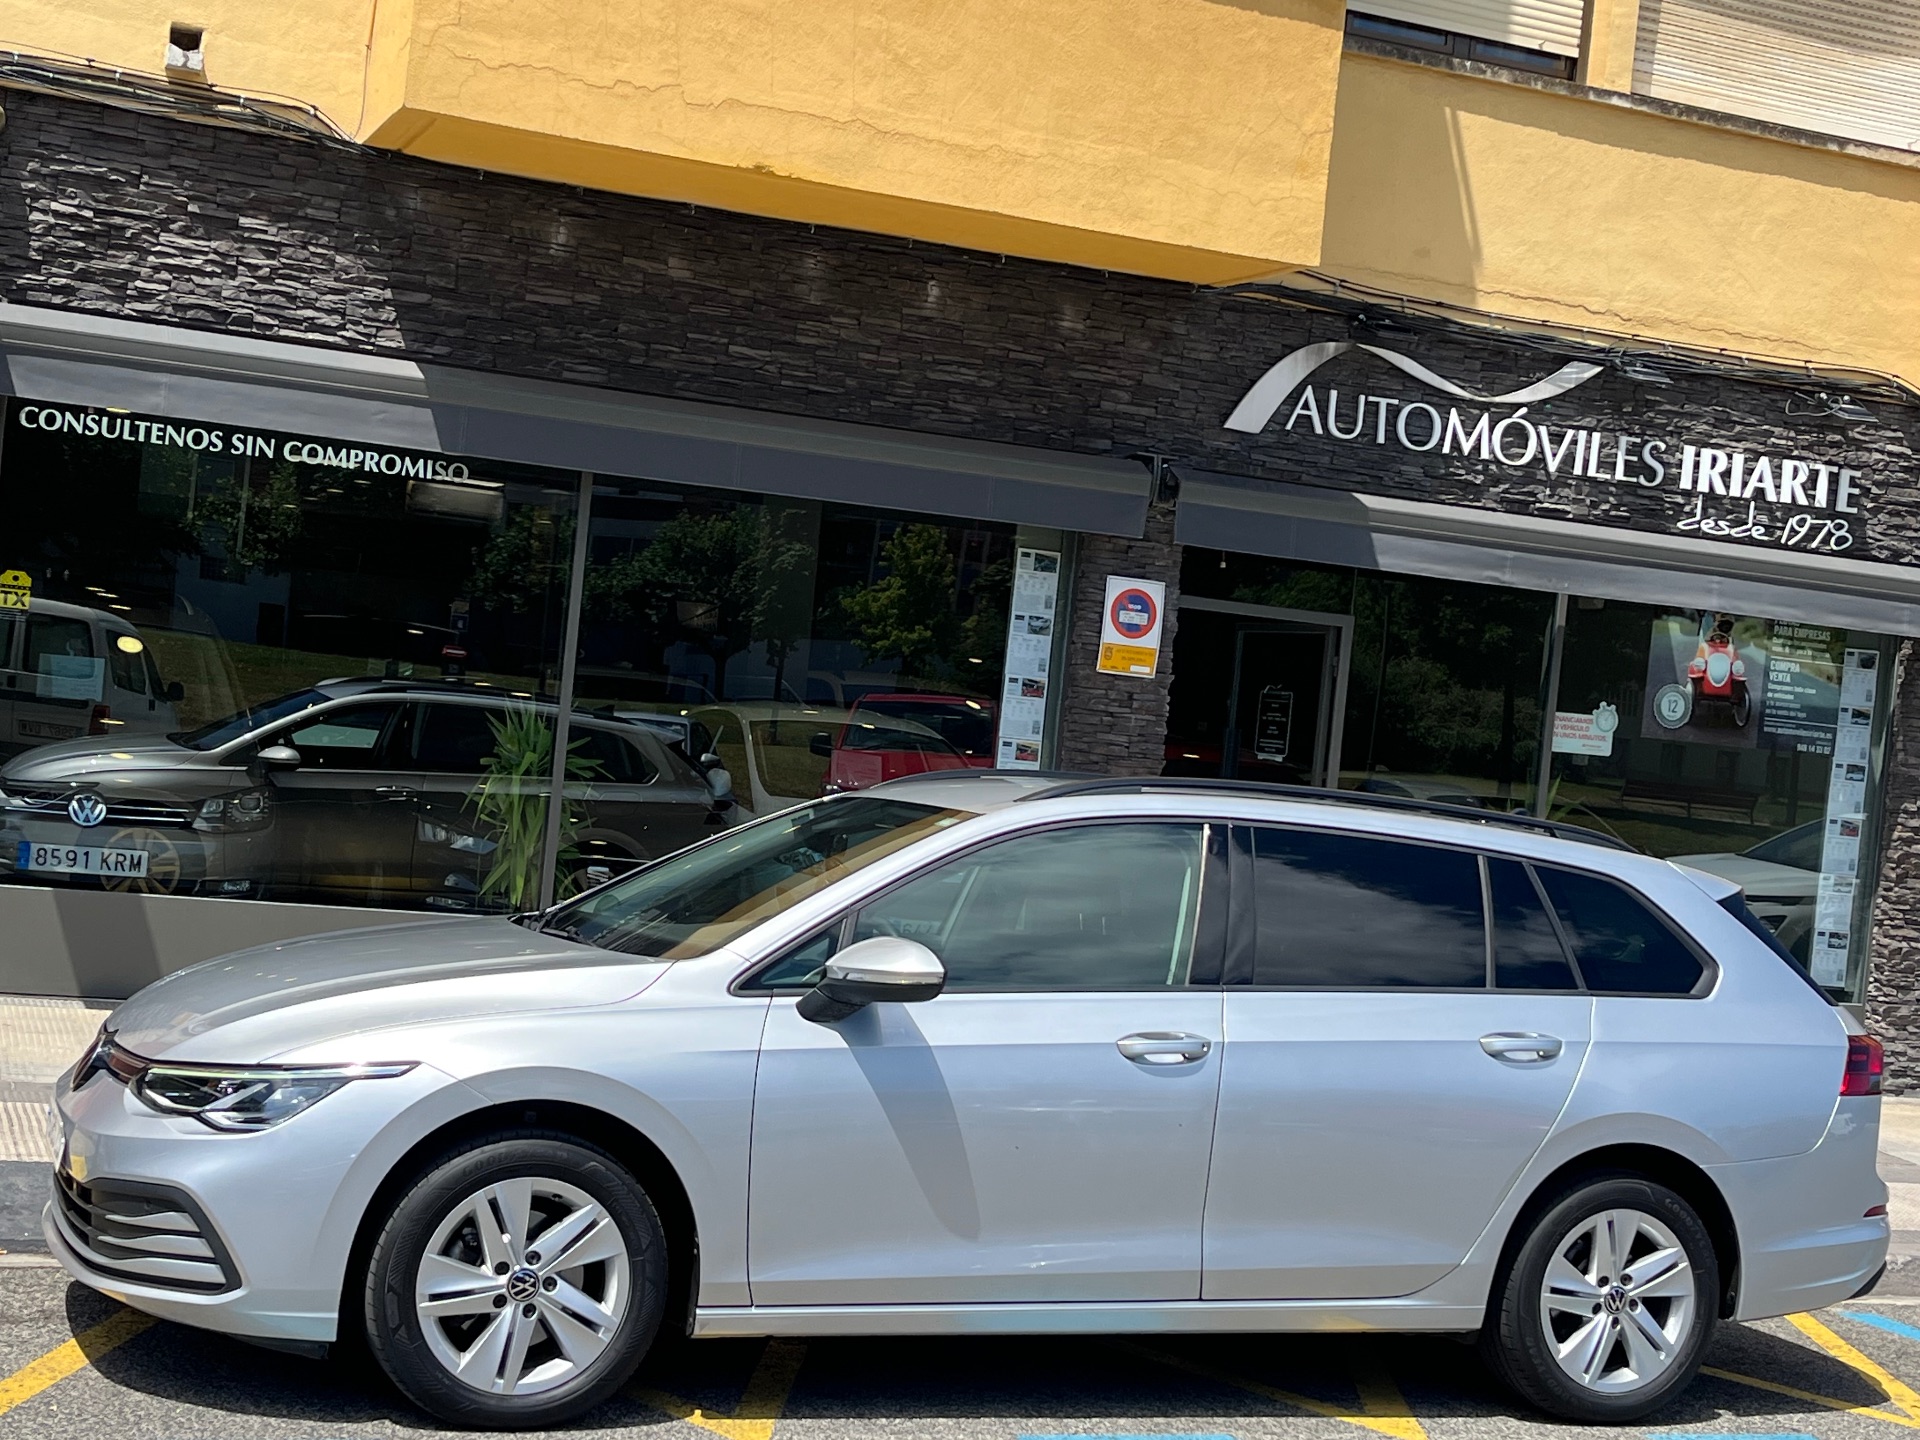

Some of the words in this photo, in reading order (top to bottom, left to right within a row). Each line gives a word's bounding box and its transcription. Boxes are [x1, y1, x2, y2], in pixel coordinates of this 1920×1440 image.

[19, 406, 223, 452] CONSULTENOS
[230, 433, 276, 459] SIN
[283, 441, 469, 484] COMPROMISO
[1284, 384, 1667, 488] AUTOMÓVILES
[1679, 444, 1862, 514] IRIARTE
[1676, 494, 1775, 541] desde
[1780, 514, 1853, 551] 1978
[1769, 671, 1791, 683] VENTA
[1770, 660, 1800, 673] COMPRA
[1667, 699, 1679, 714] 12
[35, 847, 90, 870] 8591
[100, 851, 143, 873] KRM
